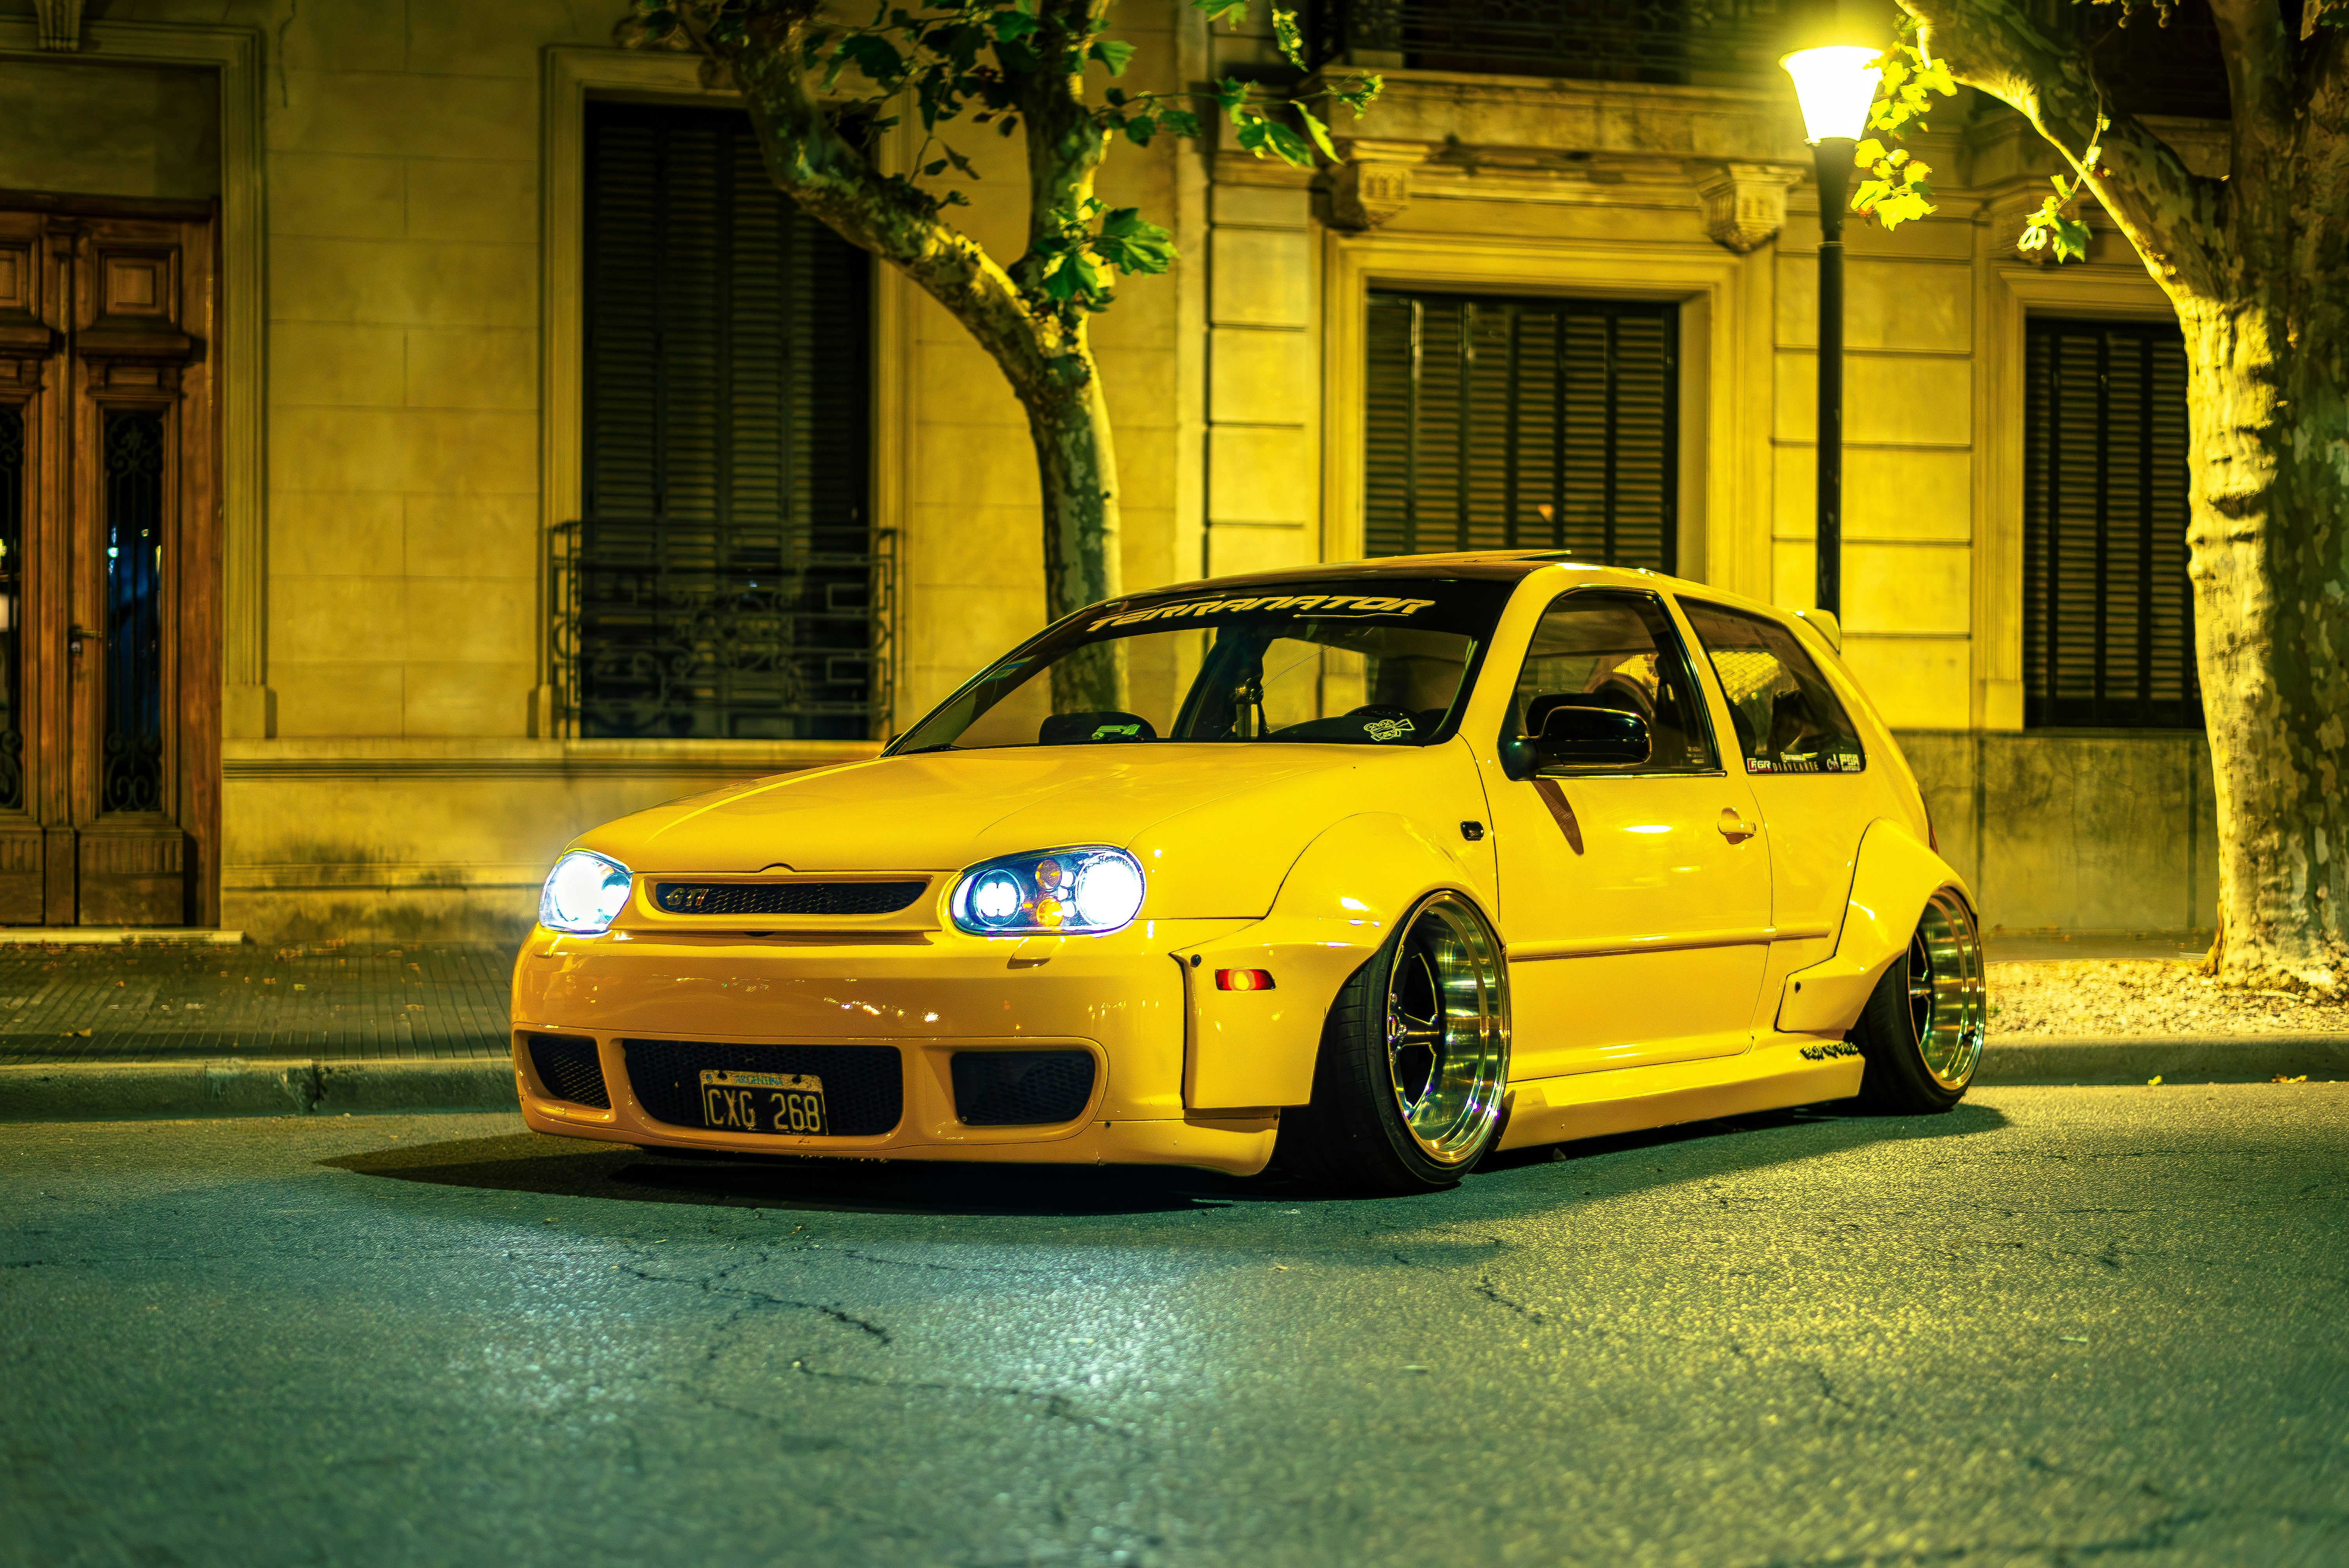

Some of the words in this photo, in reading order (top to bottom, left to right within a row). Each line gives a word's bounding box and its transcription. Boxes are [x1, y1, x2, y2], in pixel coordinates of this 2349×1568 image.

[1086, 595, 1436, 632] TERRANATOR
[665, 887, 709, 906] GTI
[707, 1089, 756, 1127] CXG
[769, 1093, 820, 1131] 268
